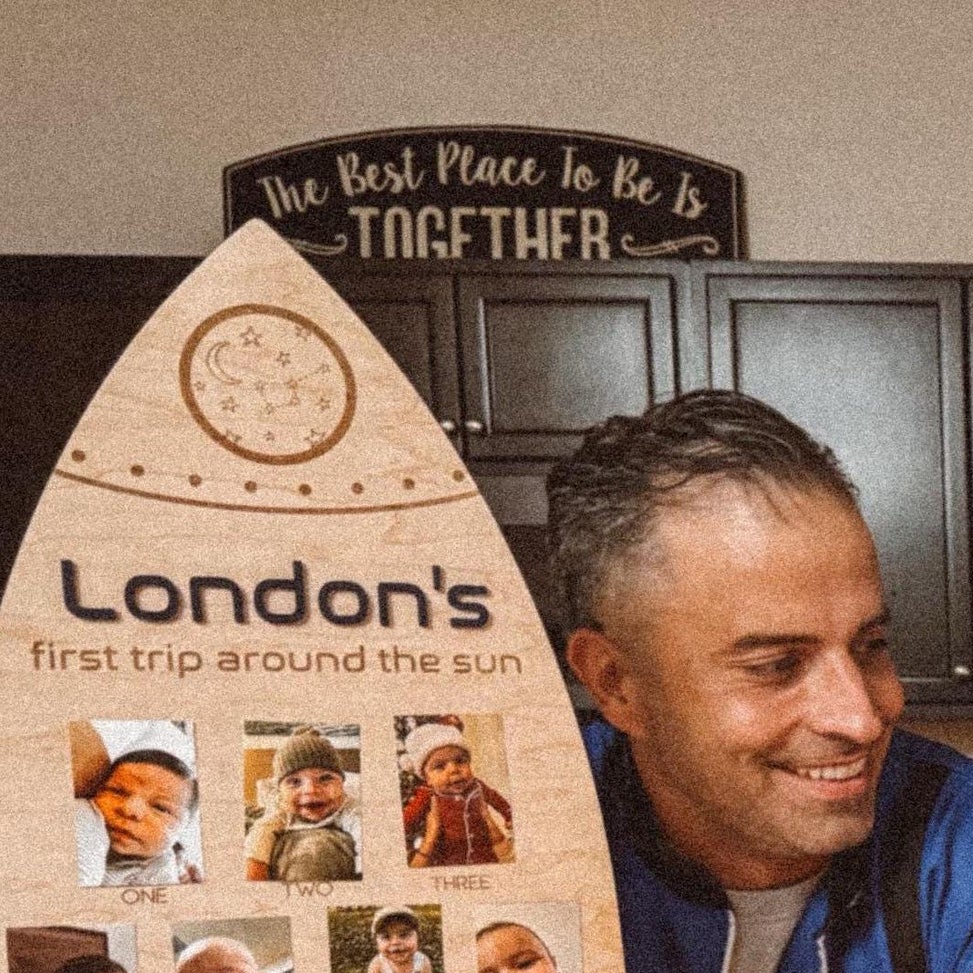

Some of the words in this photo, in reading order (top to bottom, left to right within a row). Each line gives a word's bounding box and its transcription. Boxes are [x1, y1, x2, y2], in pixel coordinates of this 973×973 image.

[257, 176, 329, 218] The
[337, 147, 424, 196] Best
[437, 142, 545, 186] Place
[561, 146, 600, 191] To
[613, 156, 661, 201] Be
[678, 173, 708, 218] Is
[348, 206, 610, 259] TOGETHER
[61, 560, 492, 629] London's
[31, 641, 117, 672] first
[130, 644, 202, 679] trip
[218, 645, 366, 674] around
[379, 645, 440, 674] the
[453, 650, 522, 675] sun
[121, 886, 167, 905] ONE
[284, 880, 334, 898] TWO
[432, 873, 490, 893] THREE
